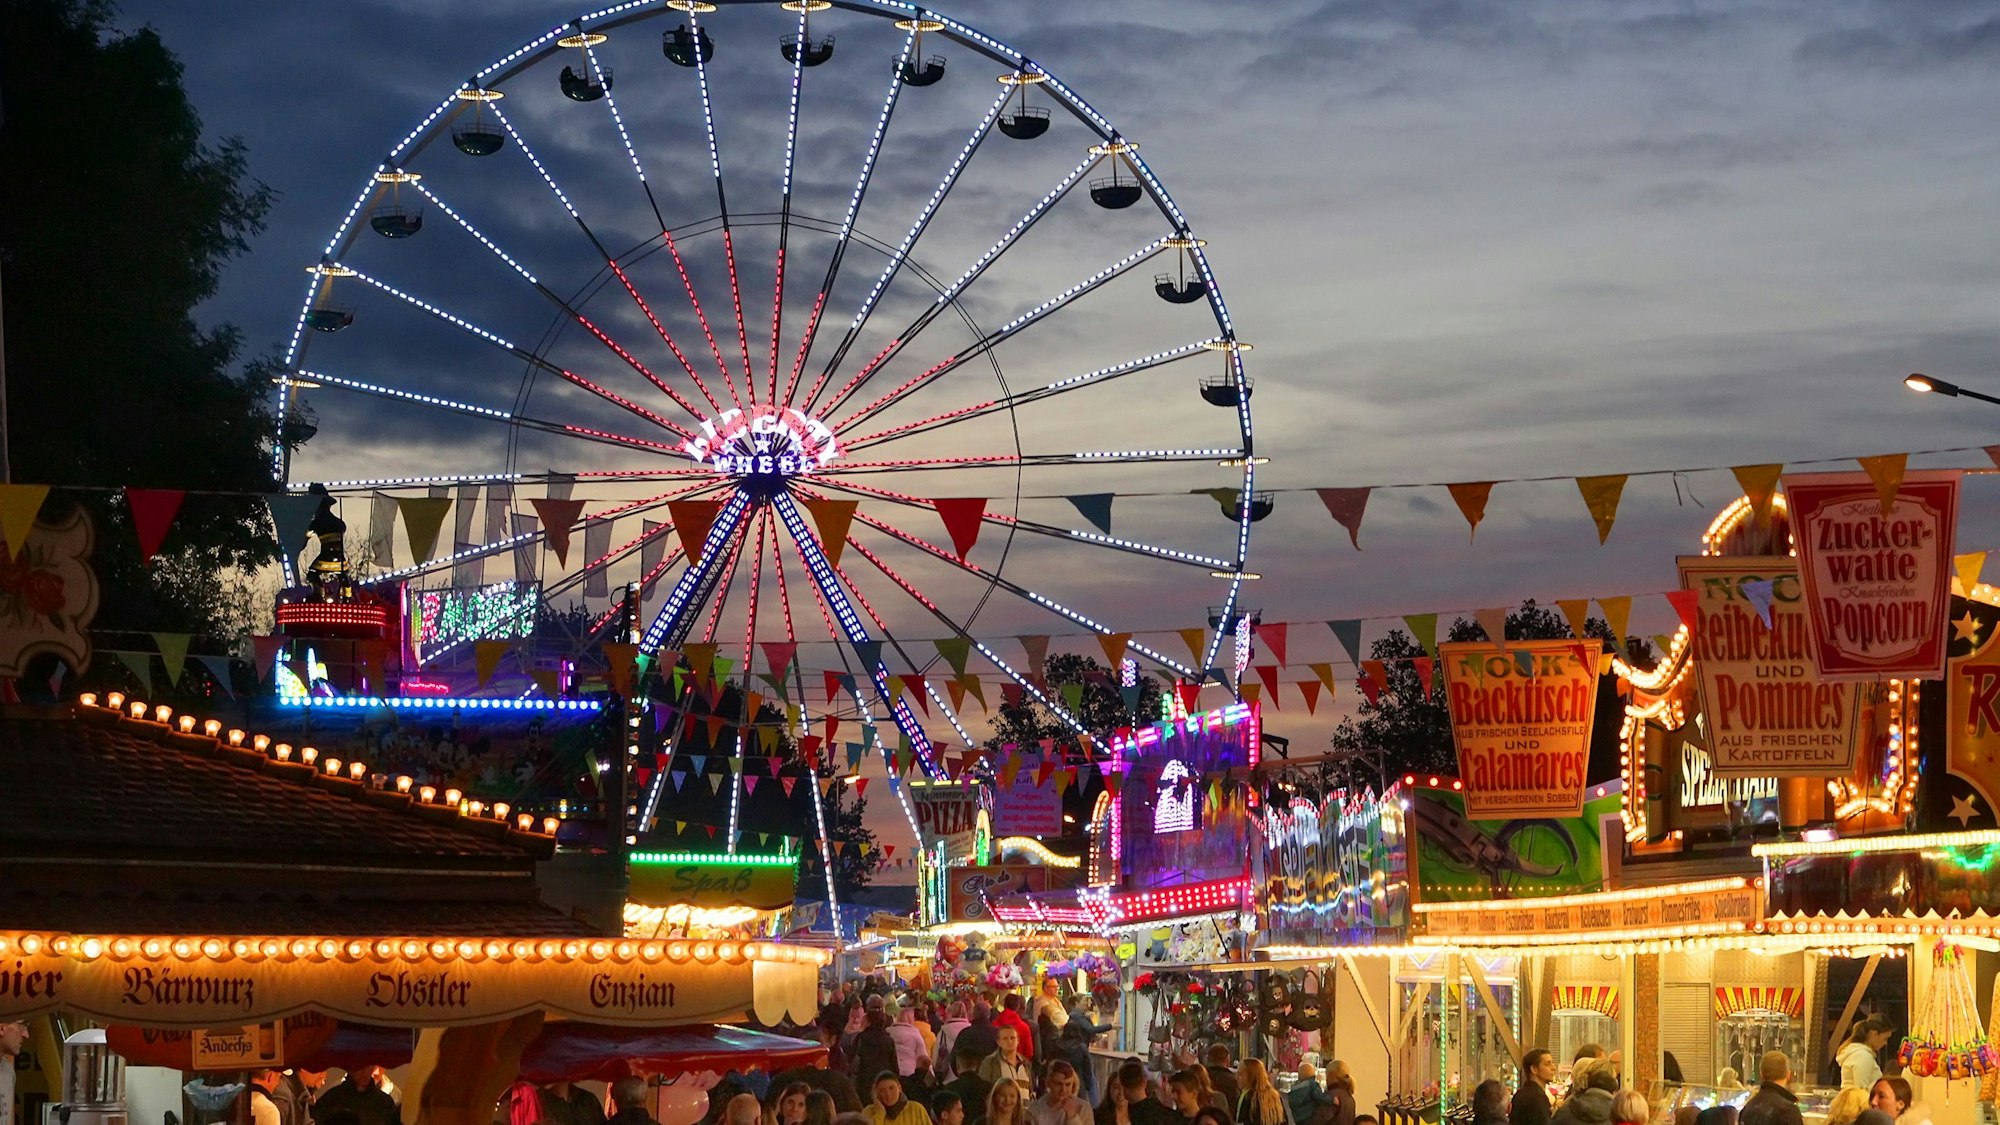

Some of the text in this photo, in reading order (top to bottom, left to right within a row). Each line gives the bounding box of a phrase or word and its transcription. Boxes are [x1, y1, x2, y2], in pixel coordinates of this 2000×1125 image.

[712, 455, 814, 473] WHEEL
[1818, 517, 1933, 551] Zucker-
[1826, 550, 1917, 583] watte
[1692, 604, 1812, 661] Reibeku
[1824, 598, 1928, 652] Popcorn
[1756, 666, 1804, 678] UND
[1450, 679, 1587, 725] Backfisch
[1715, 674, 1846, 731] Pommes
[1476, 727, 1519, 738] FRISCHEM
[1505, 741, 1540, 750] UND
[1720, 734, 1842, 746] AUS FRISCHEN
[1461, 748, 1583, 792] Calamares
[1729, 748, 1835, 761] KARTOFFELN
[914, 801, 973, 835] PIZZA
[670, 865, 752, 898] Spaß
[121, 966, 254, 1011] Bärwurz
[365, 971, 471, 1008] Obstler
[590, 973, 675, 1014] Enzian
[200, 1036, 253, 1057] Andechs
